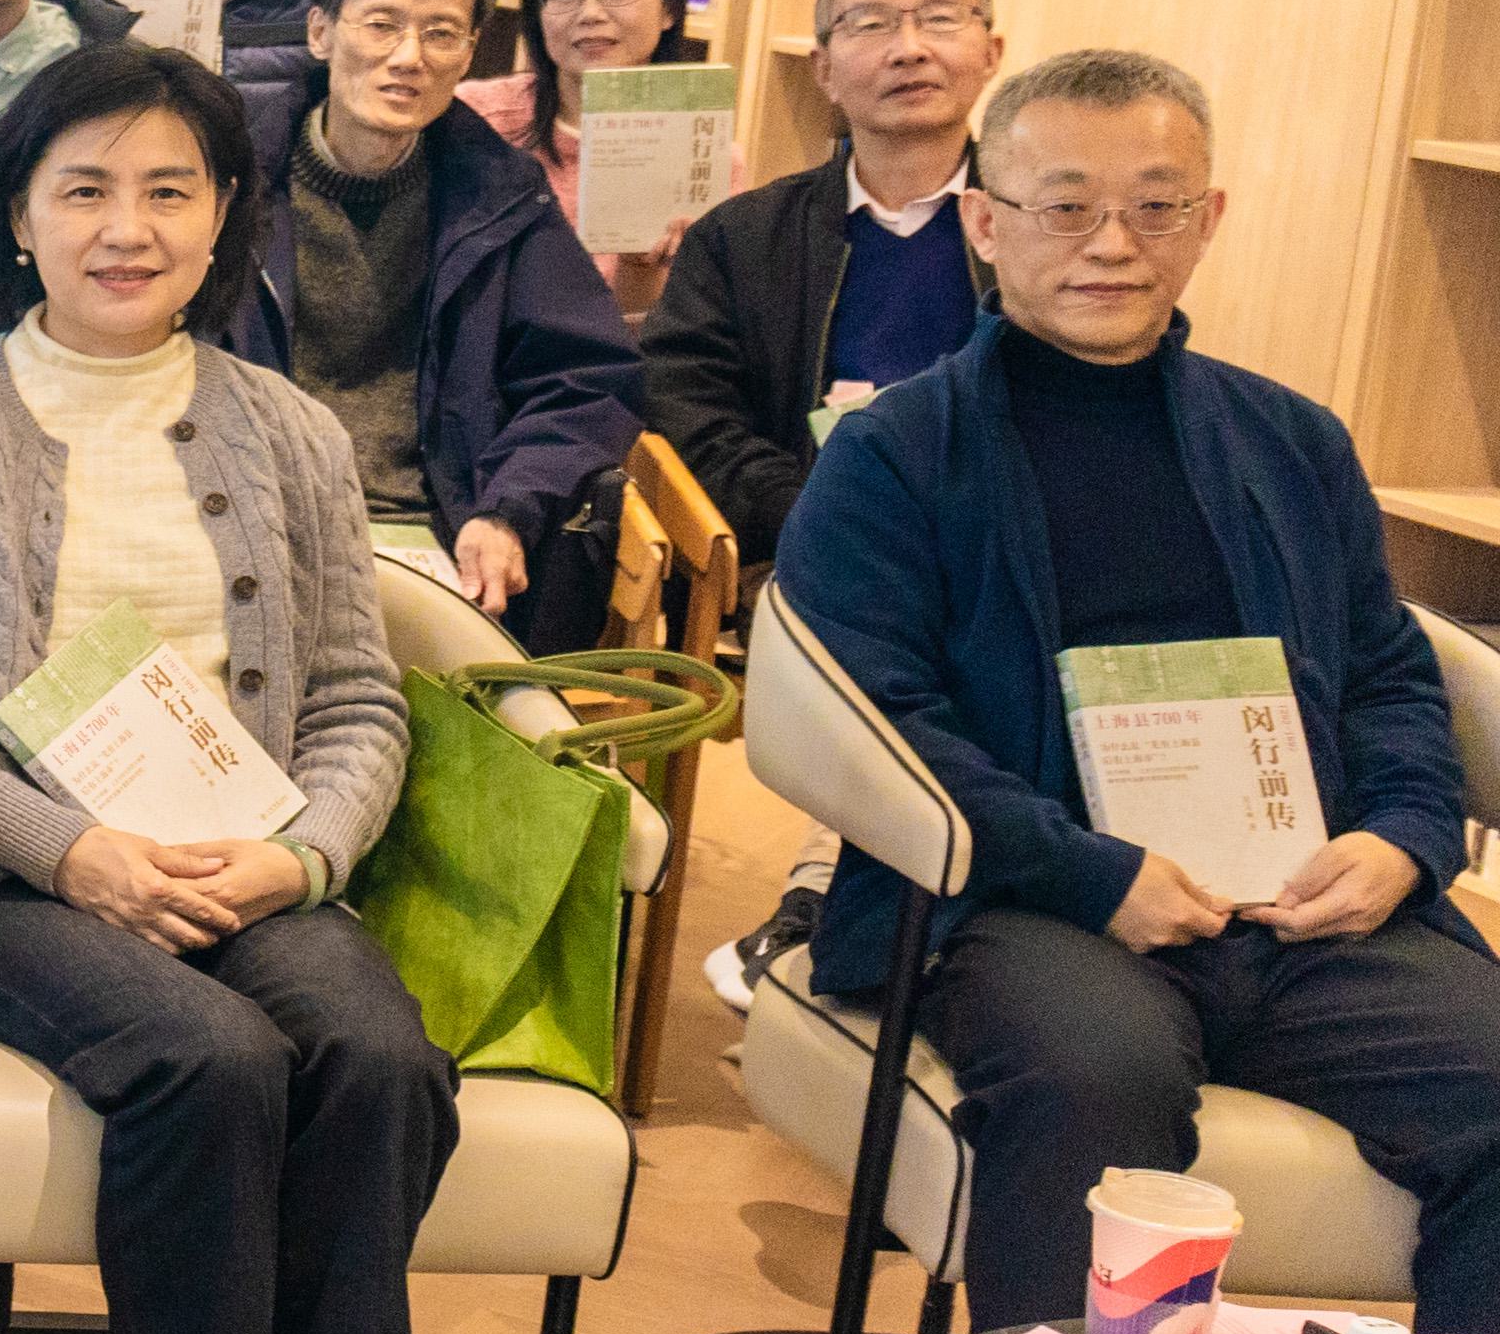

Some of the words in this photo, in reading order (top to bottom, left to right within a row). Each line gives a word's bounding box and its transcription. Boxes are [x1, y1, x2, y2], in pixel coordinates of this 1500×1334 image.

[51, 703, 121, 767] 上海县700年
[140, 665, 239, 776] 闵行前传
[1097, 709, 1202, 730] 上海县700年
[1242, 705, 1295, 830] 闵行前传
